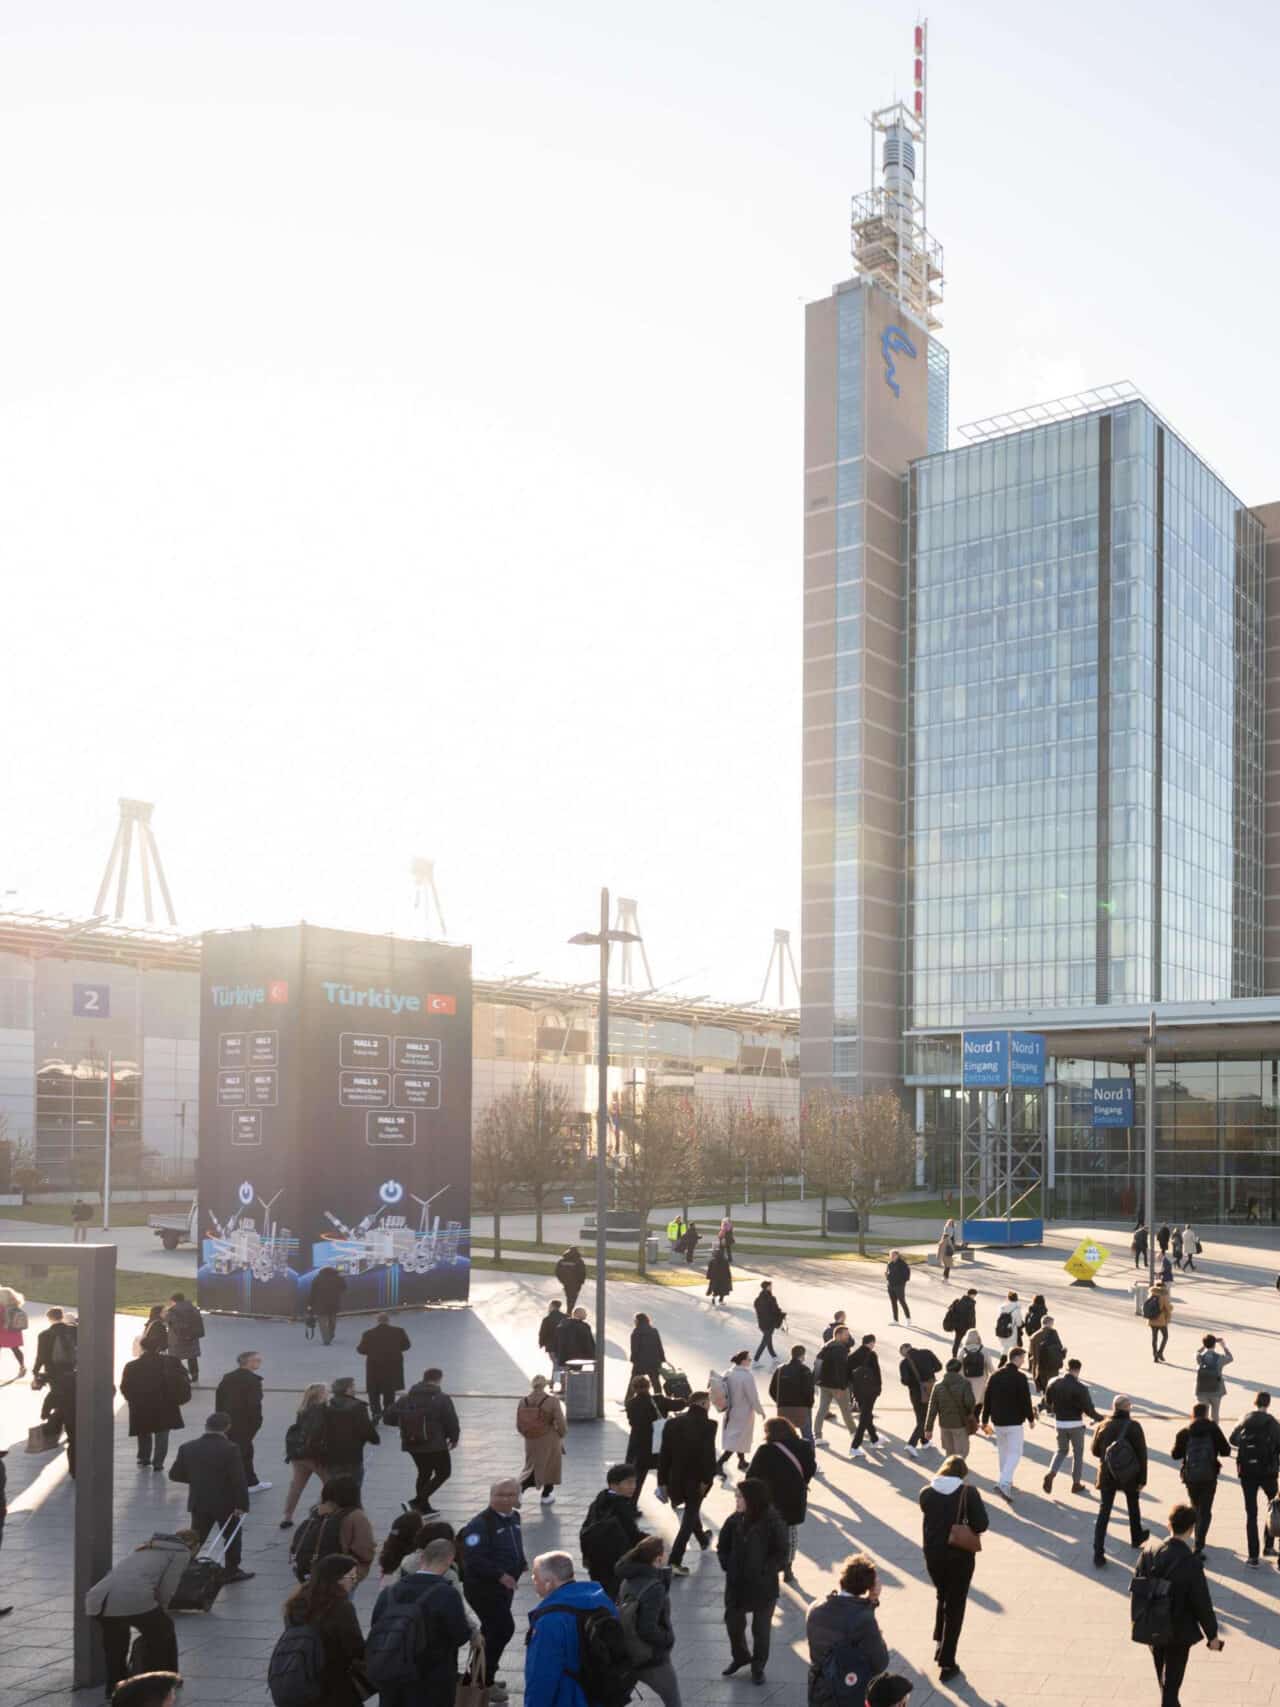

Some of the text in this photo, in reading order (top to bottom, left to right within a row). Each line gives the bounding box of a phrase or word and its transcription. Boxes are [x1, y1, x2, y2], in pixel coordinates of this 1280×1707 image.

[84, 990, 99, 1009] 2
[211, 984, 265, 1009] Türkiye
[321, 979, 420, 1014] Türkiye
[965, 1040, 1001, 1054] Nord 1
[1012, 1040, 1040, 1055] Nord 1
[965, 1062, 999, 1073] Eingang
[1012, 1062, 1039, 1075] Eingang
[1094, 1087, 1132, 1100] Nord 1
[1094, 1105, 1123, 1115] Eingang
